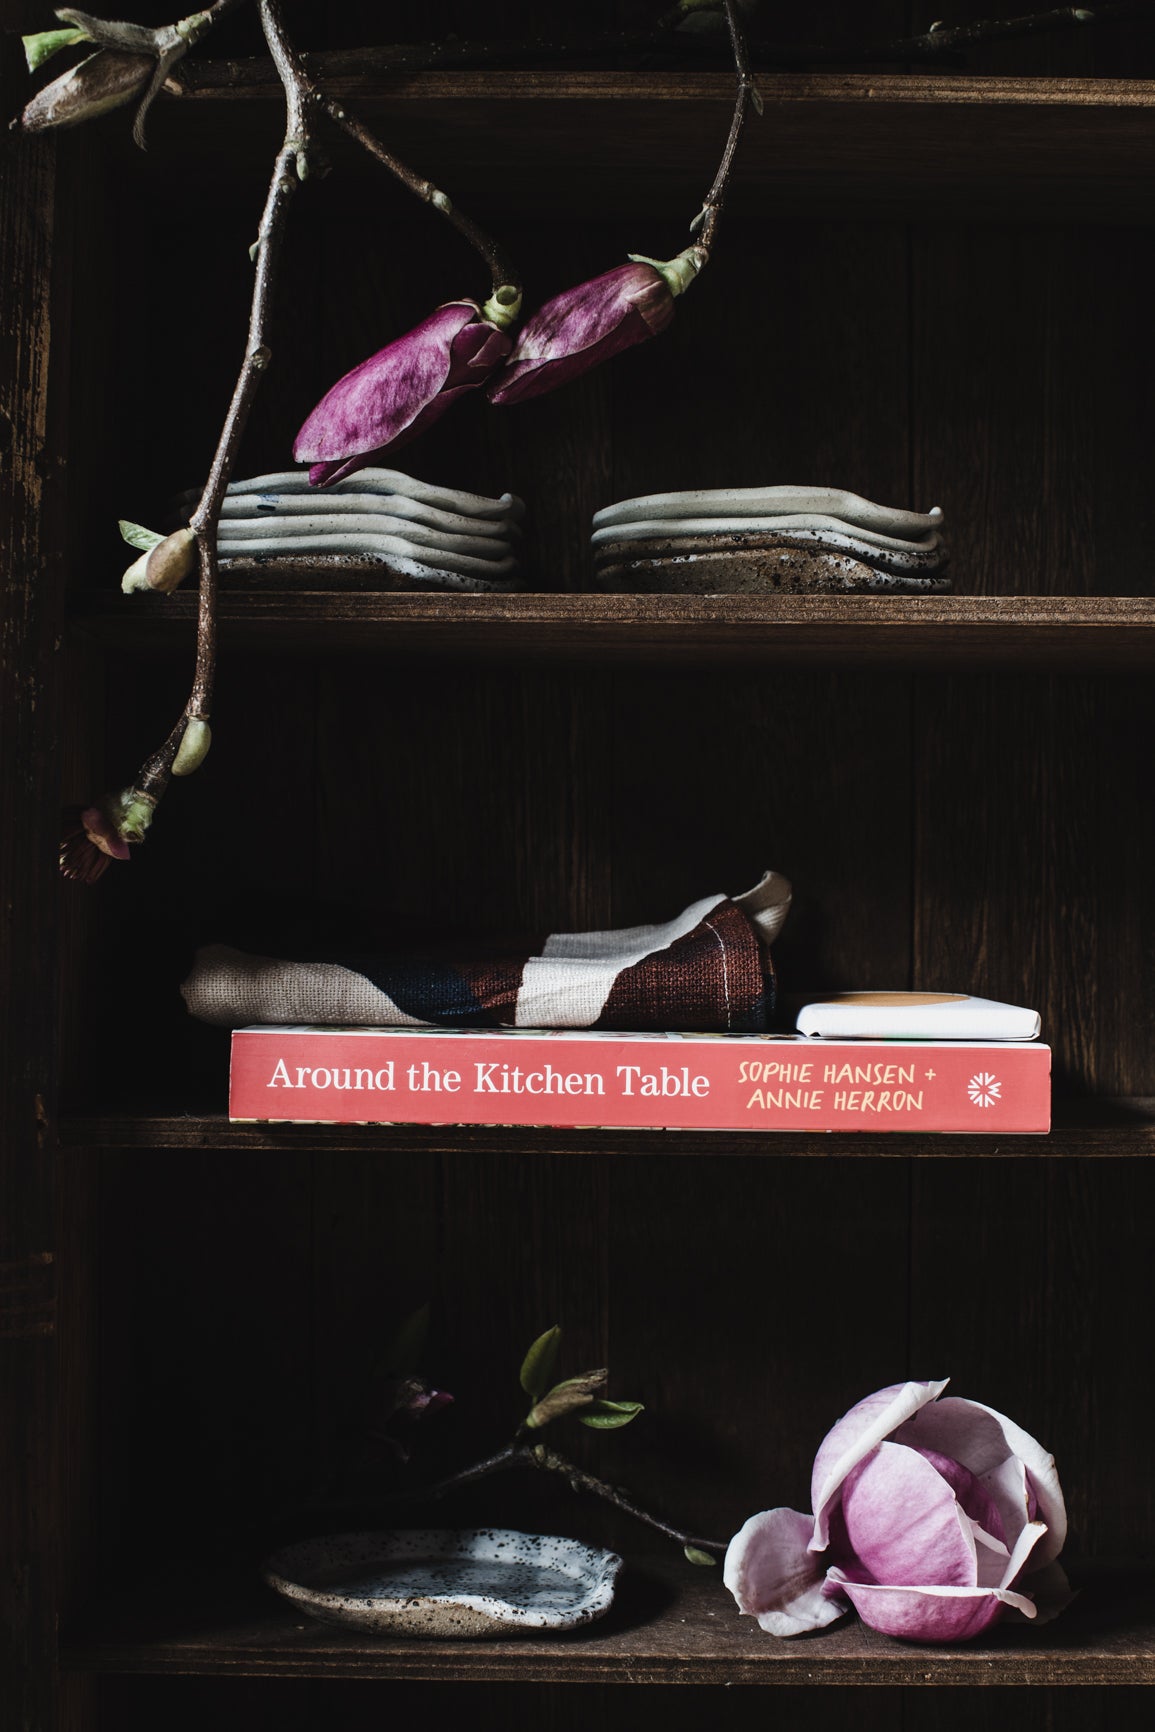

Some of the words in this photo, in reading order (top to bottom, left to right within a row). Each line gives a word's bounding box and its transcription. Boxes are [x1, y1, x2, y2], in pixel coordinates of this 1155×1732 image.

[266, 1058, 396, 1090] Around
[406, 1062, 461, 1092] the
[473, 1063, 605, 1096] Kitchen
[616, 1066, 710, 1097] Table
[738, 1061, 815, 1083] SOPHIE
[824, 1063, 915, 1085] HANSEN
[925, 1069, 936, 1081] +
[746, 1089, 824, 1110] ANNIE
[834, 1090, 923, 1112] HERRON
